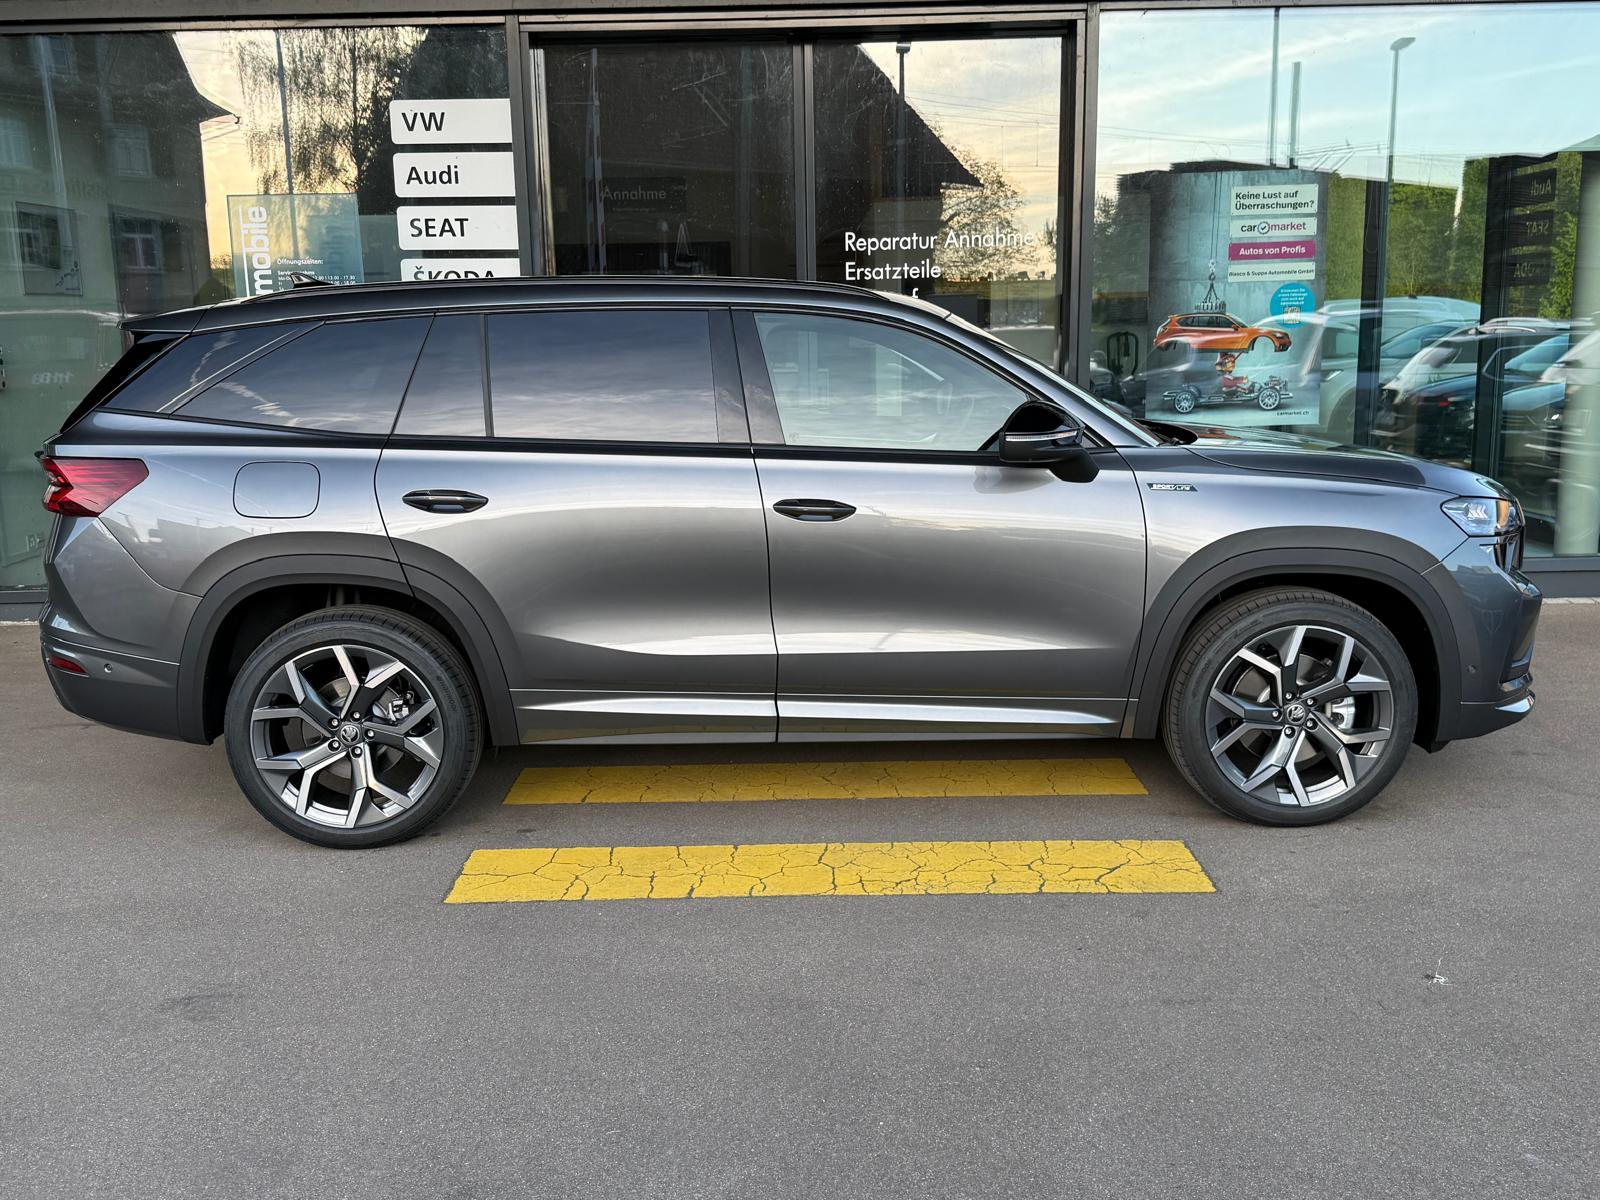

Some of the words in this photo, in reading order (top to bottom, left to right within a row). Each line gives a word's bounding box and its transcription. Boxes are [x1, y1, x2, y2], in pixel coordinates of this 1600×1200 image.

[401, 112, 445, 132] VW
[406, 165, 460, 185] Audi
[601, 185, 667, 201] Annahme
[1235, 192, 1261, 200] Keine
[1262, 191, 1282, 200] Lust
[1283, 190, 1299, 199] auf
[1235, 200, 1315, 211] Überraschungen?
[409, 218, 469, 238] SEAT
[844, 232, 938, 256] Reparatur
[944, 227, 1036, 249] Annahme
[1239, 247, 1263, 256] Autos
[1281, 245, 1306, 254] Profis
[845, 259, 942, 281] Ersatzteile
